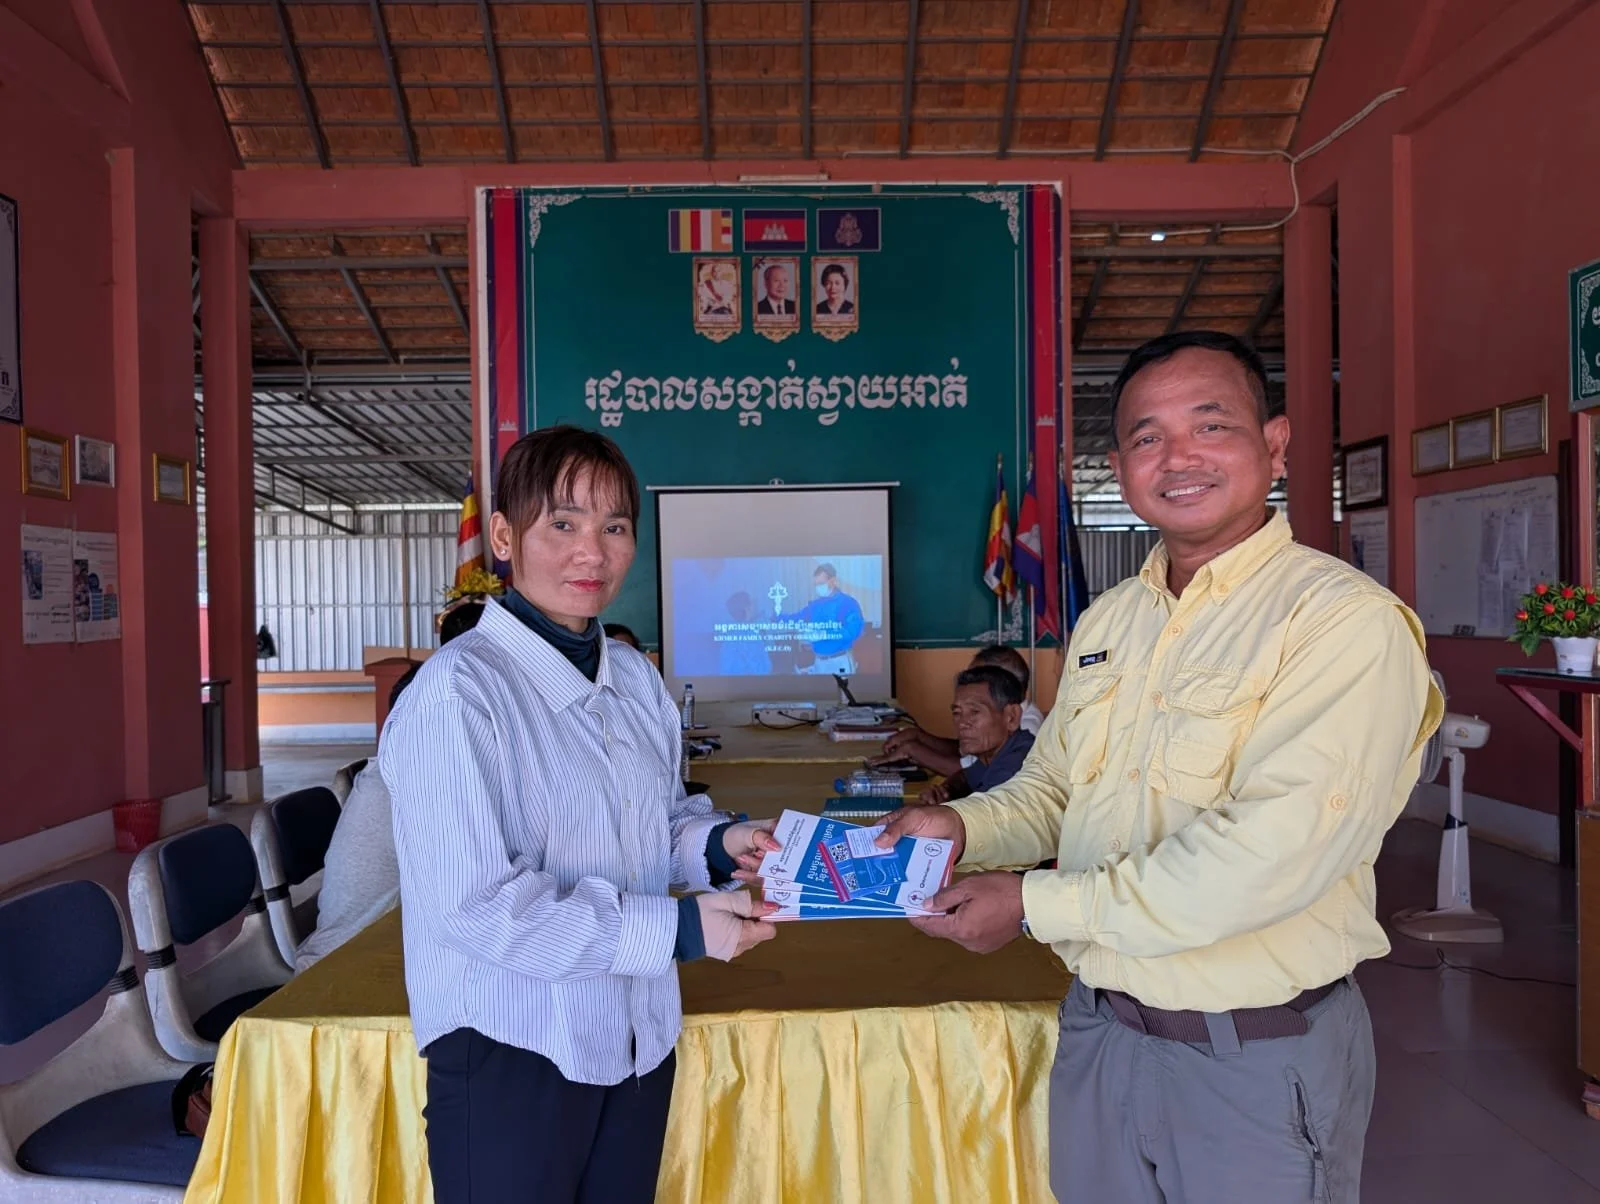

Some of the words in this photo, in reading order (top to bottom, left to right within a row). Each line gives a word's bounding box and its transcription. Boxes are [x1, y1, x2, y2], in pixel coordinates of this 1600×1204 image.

[584, 356, 969, 428] រដ្ឋបាលសង្កាត់ស្វាយអាត់
